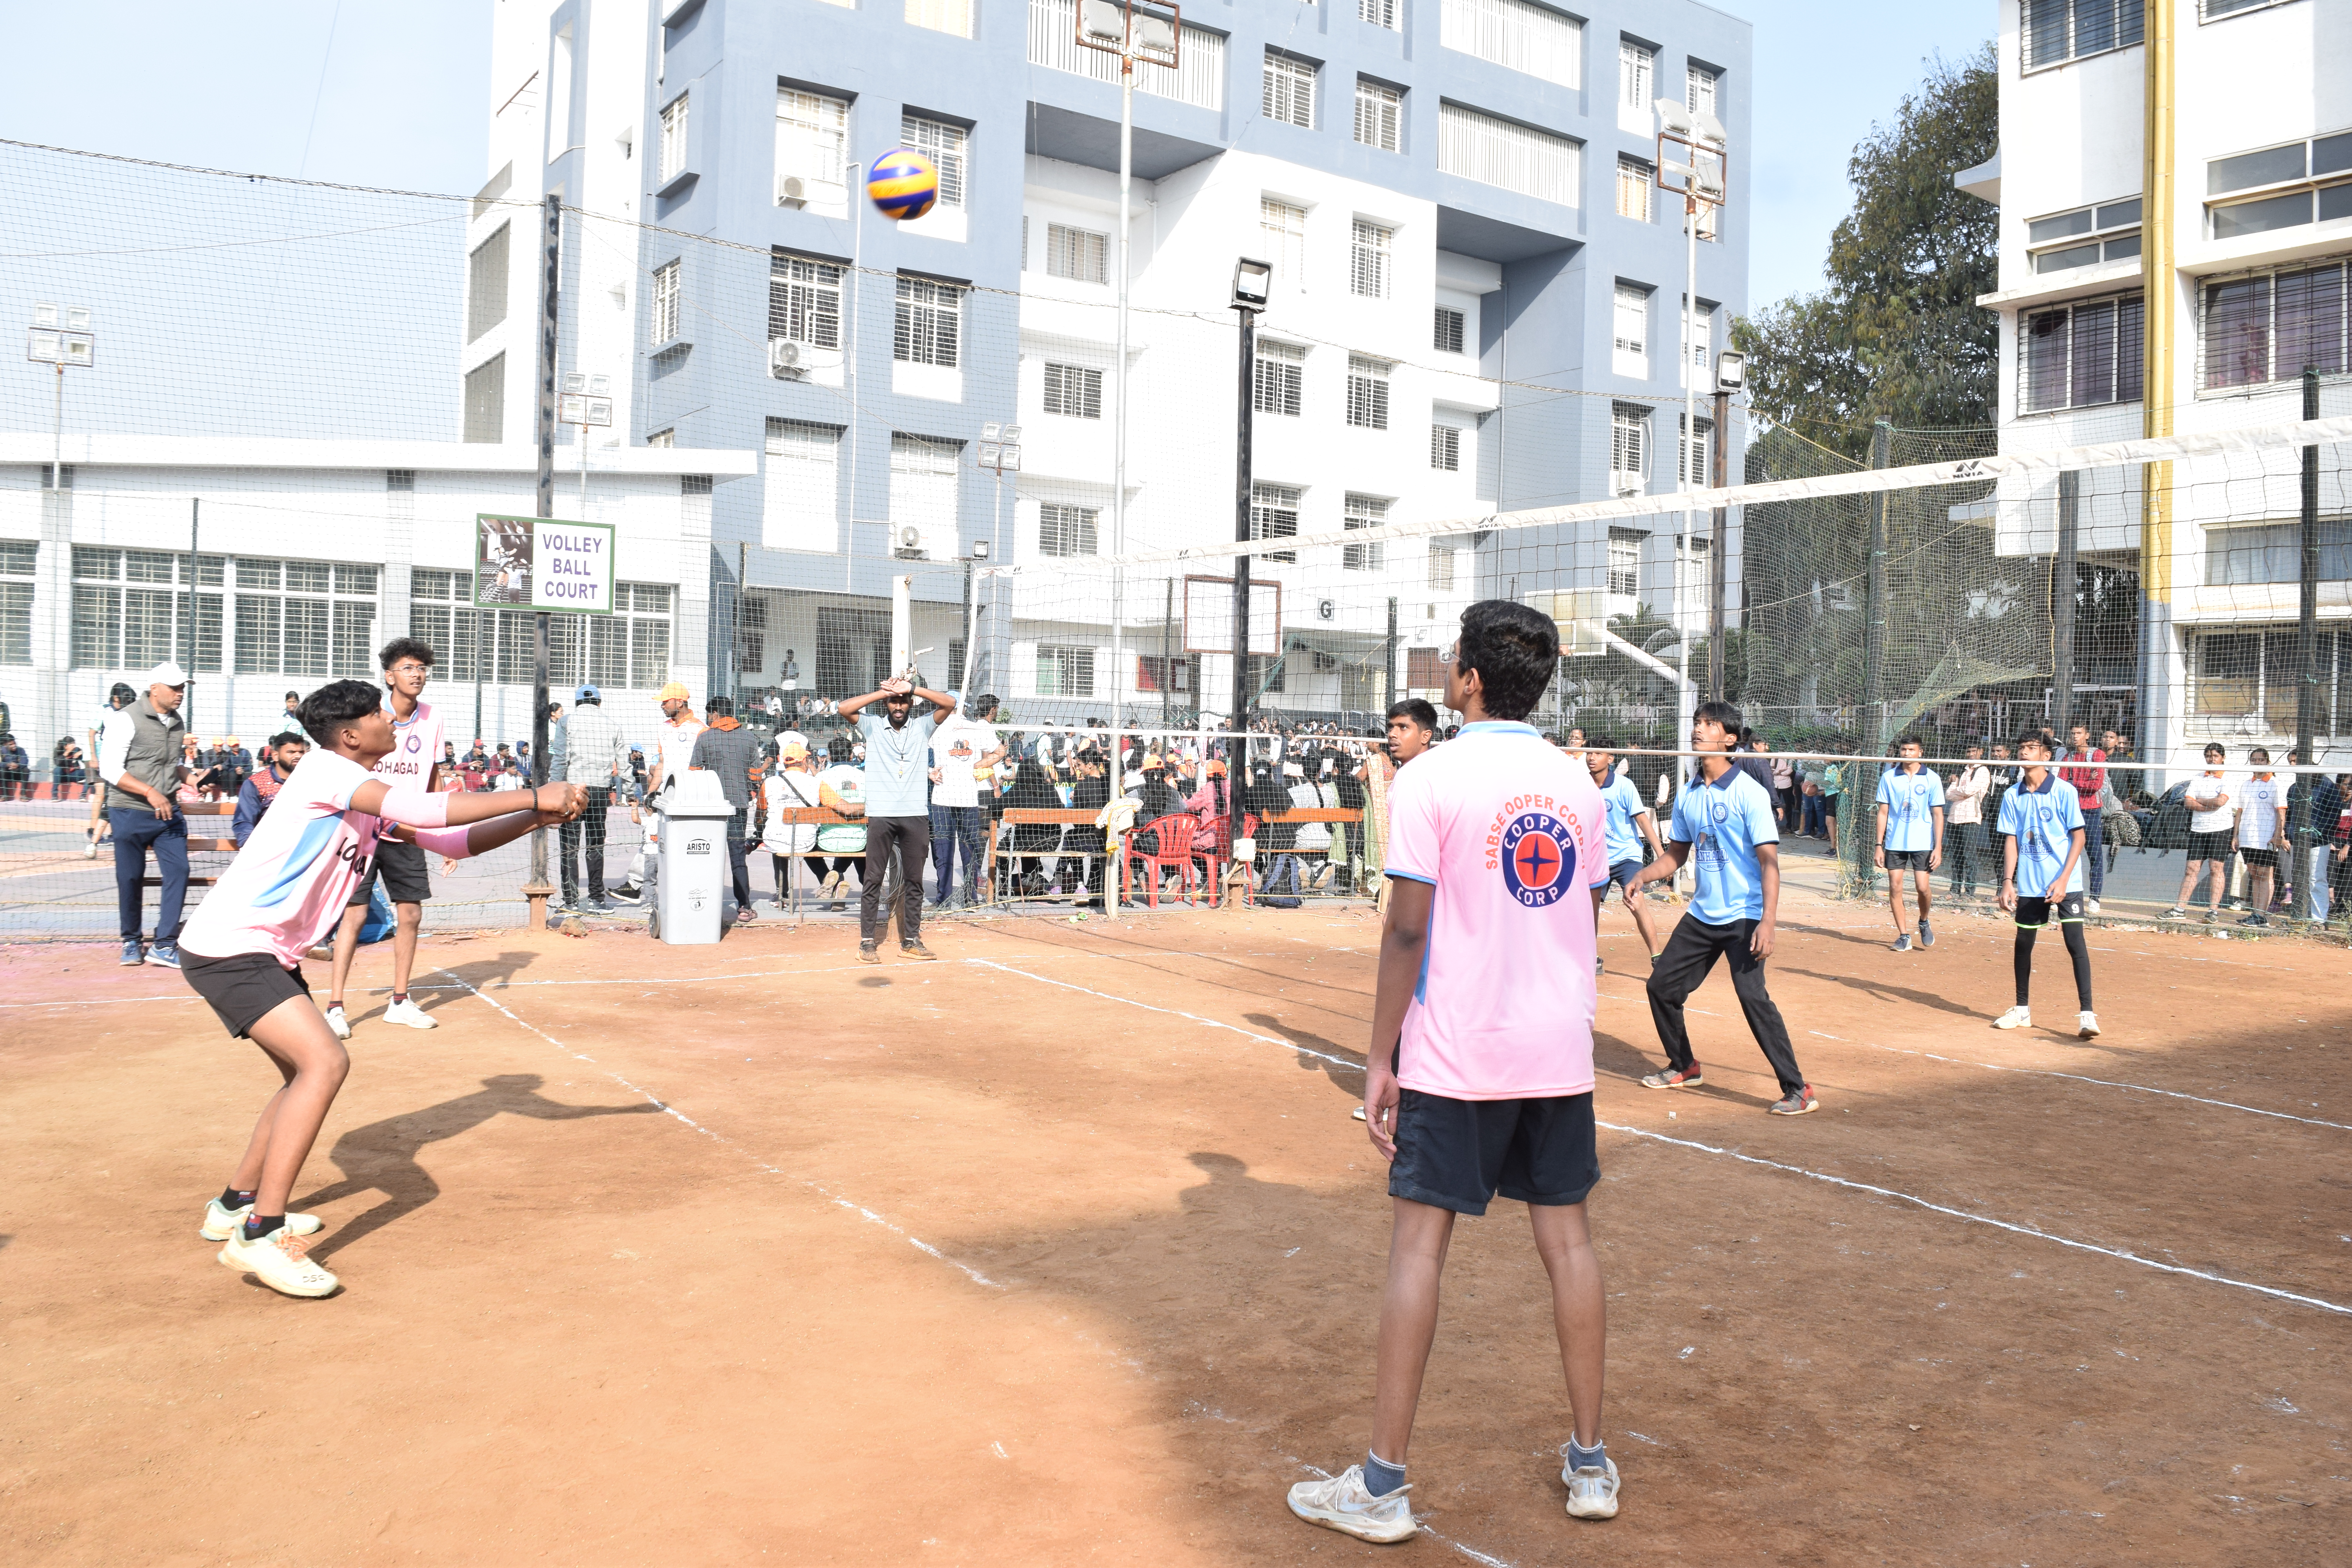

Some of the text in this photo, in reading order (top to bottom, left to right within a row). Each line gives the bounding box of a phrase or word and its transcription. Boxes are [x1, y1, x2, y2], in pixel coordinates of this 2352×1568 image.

[543, 534, 603, 553] VOLLEY
[553, 558, 591, 576] BALL
[545, 581, 598, 599] COURT
[1320, 600, 1332, 618] G
[1485, 794, 1585, 870] SABSE OOPER COOP
[1504, 815, 1572, 851] COOPER
[1517, 886, 1559, 905] CORP
[2071, 904, 2080, 914] 9
